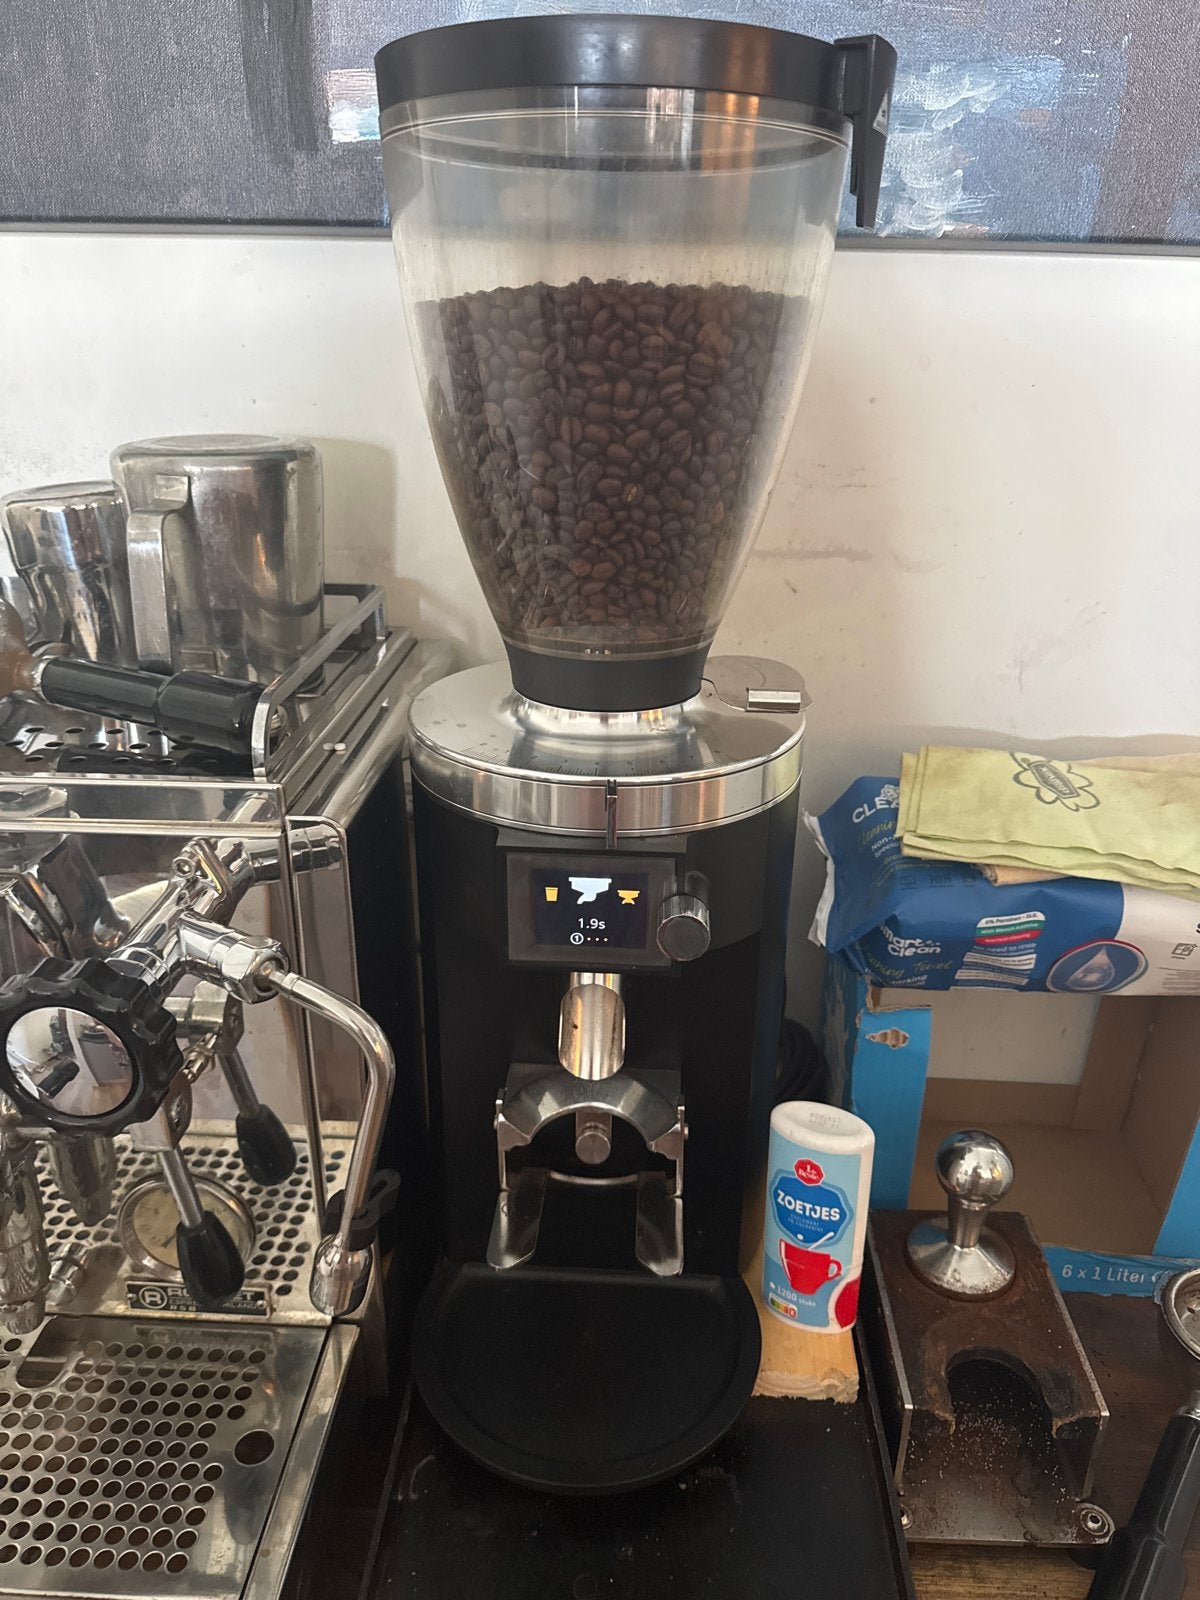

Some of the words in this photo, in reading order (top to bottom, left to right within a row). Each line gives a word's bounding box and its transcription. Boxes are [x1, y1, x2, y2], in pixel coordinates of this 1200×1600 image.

[578, 917, 606, 930] 1.9s
[887, 943, 942, 957] Clean
[776, 1189, 841, 1221] ZOETJES
[1062, 1264, 1073, 1278] 6
[1077, 1268, 1087, 1279] x
[1091, 1266, 1101, 1280] 1
[777, 1285, 798, 1302] 1200
